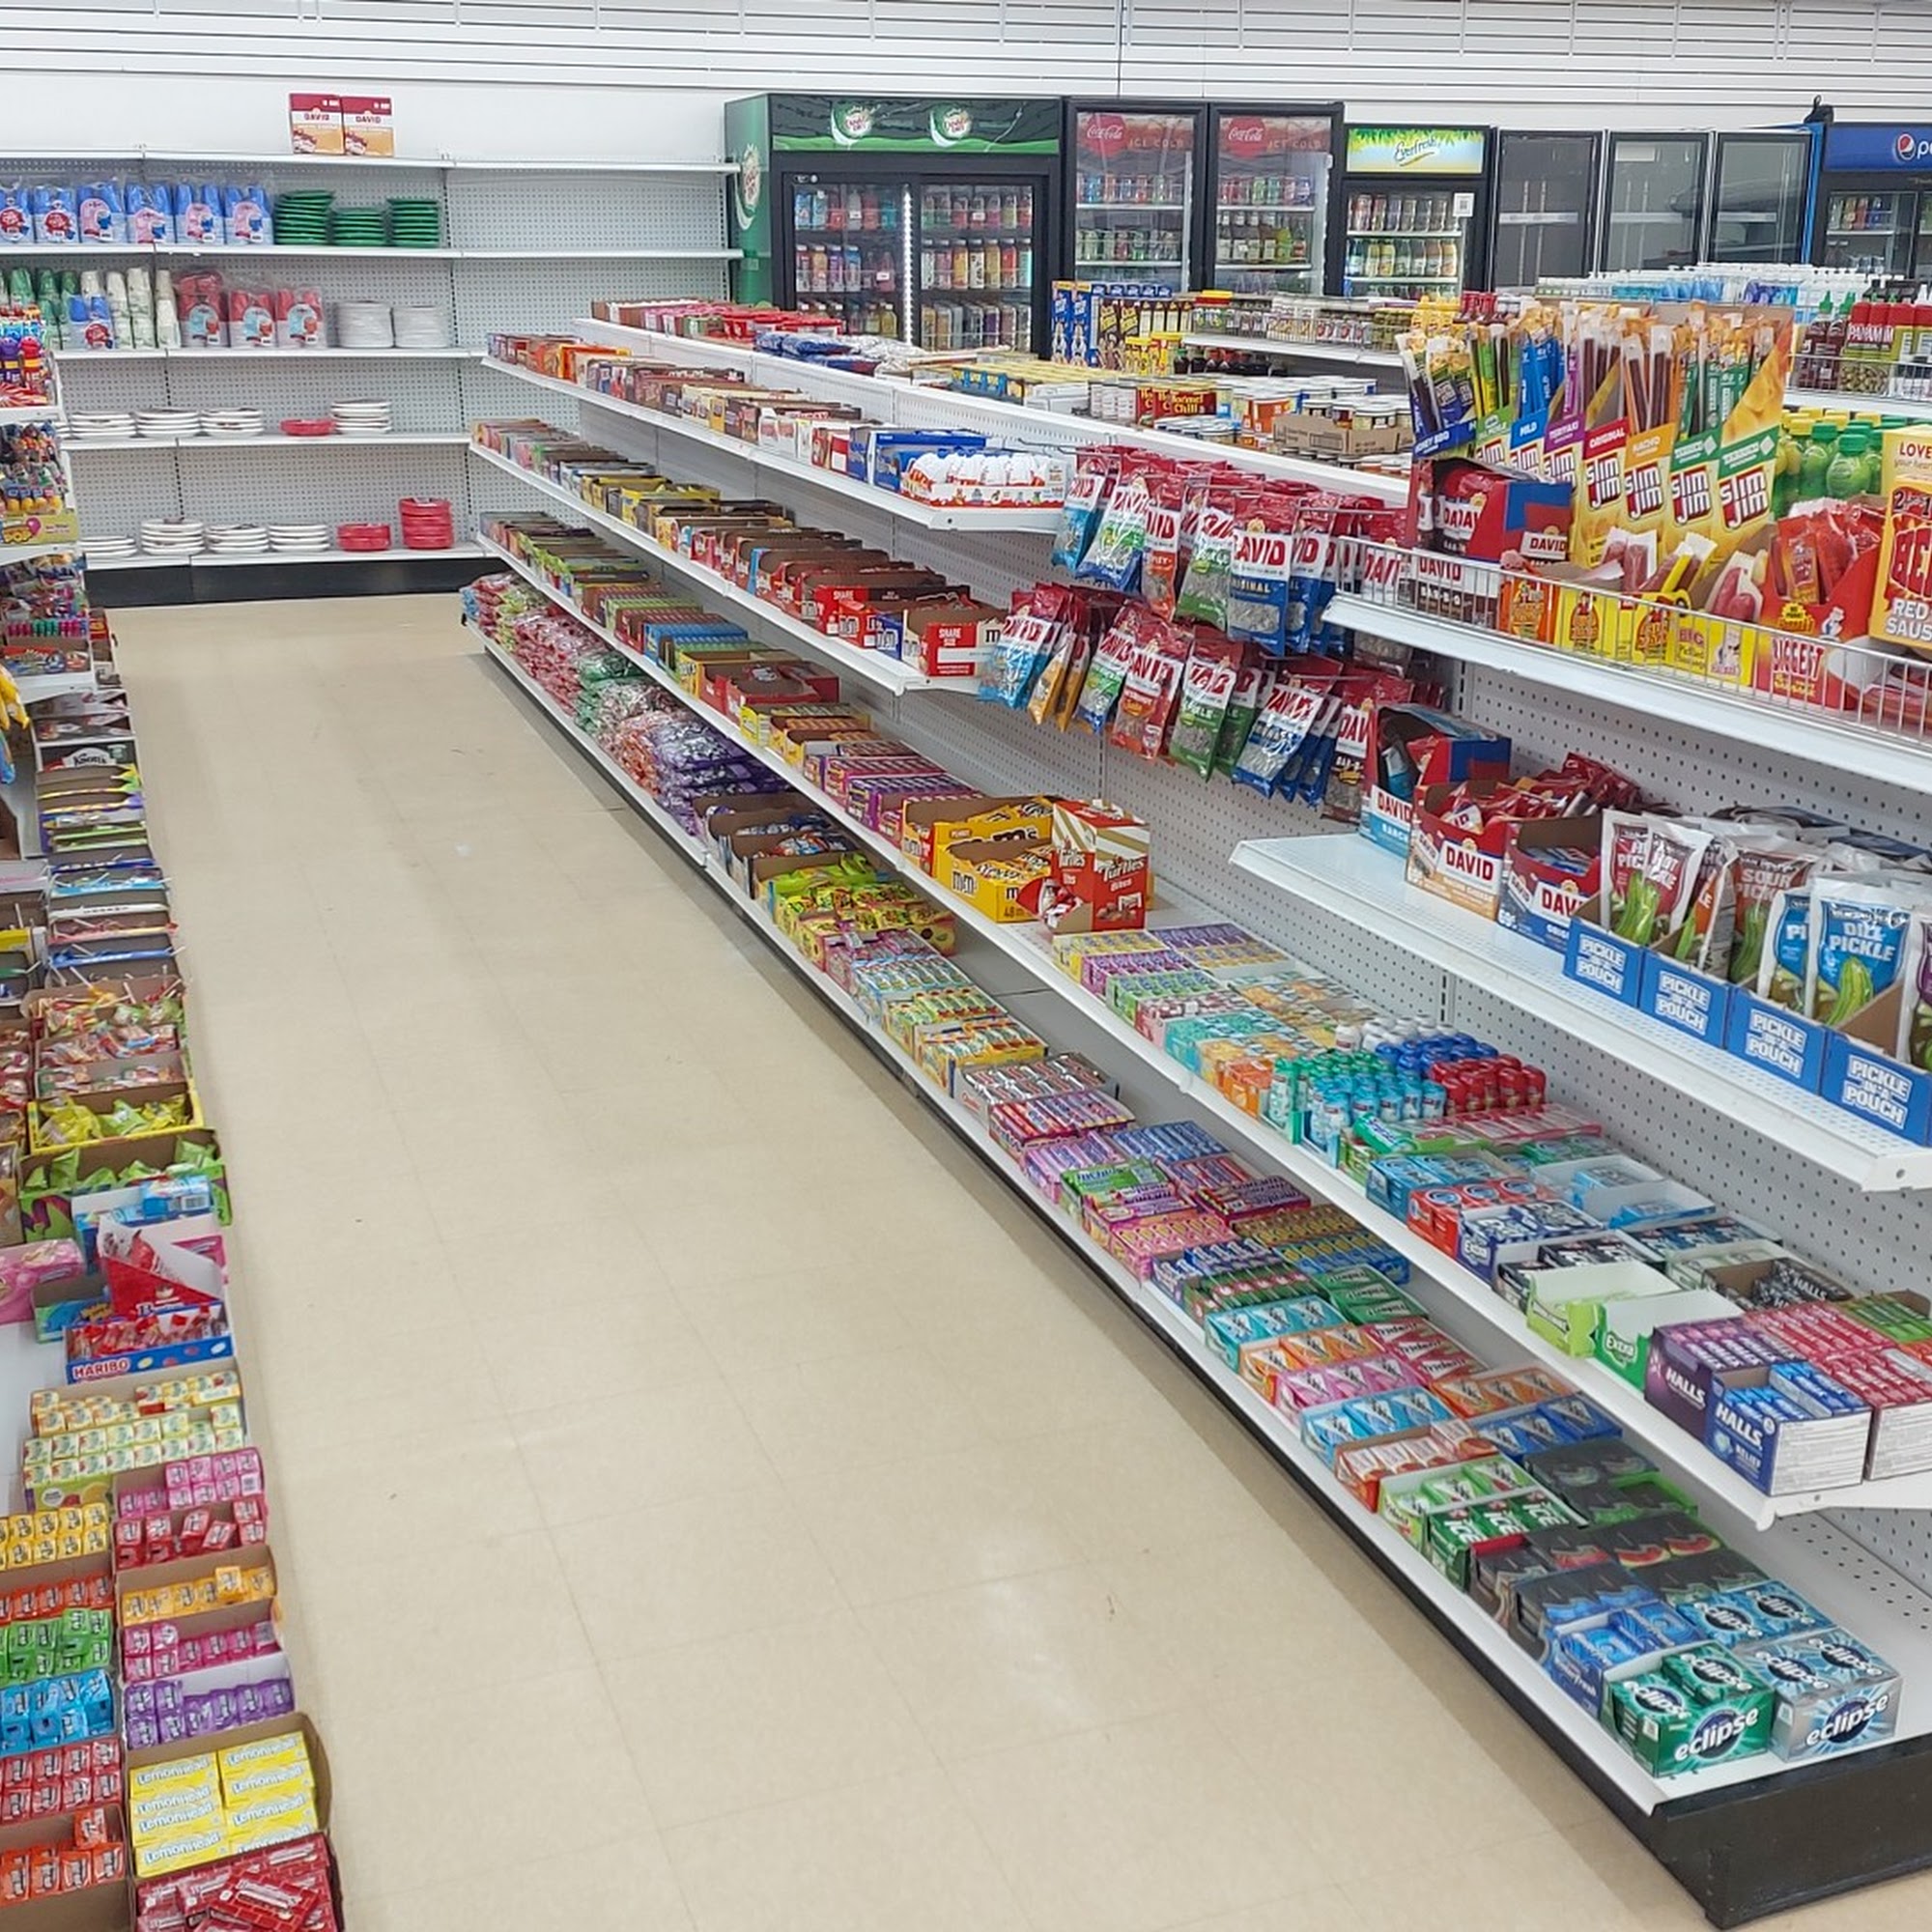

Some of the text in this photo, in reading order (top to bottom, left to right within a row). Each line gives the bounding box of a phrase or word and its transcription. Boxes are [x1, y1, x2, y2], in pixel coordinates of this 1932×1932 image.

[1175, 404, 1198, 414] Chili
[1520, 422, 1537, 437] MILD
[1510, 446, 1539, 469] slim
[1544, 451, 1574, 476] slim
[1586, 456, 1620, 481] slim
[1591, 477, 1620, 508] jim
[1625, 465, 1661, 494] slim
[1671, 469, 1708, 497] slim
[1720, 471, 1766, 505] slim
[1631, 487, 1662, 519] jim
[1677, 491, 1711, 524] jim
[1728, 493, 1769, 528] jim
[1234, 535, 1287, 566] AVID
[1530, 537, 1567, 552] DAVID
[1893, 598, 1929, 620] RED
[939, 628, 961, 639] SHARE
[1103, 860, 1145, 883] Turtles
[1446, 846, 1493, 881] DAVID
[1741, 869, 1792, 888] SOUR
[1542, 889, 1584, 918] DAV
[1580, 936, 1625, 968] PICKLE
[1830, 935, 1895, 962] PICKLE
[1577, 960, 1623, 994] POUCH
[1662, 974, 1710, 1009] PICKLE
[1658, 997, 1707, 1033] POUCH
[1752, 1012, 1804, 1050] PICKLE
[1748, 1037, 1802, 1075] POUCH
[1851, 1059, 1910, 1097] PICKLE
[1846, 1086, 1905, 1124] POUCH
[1793, 1276, 1828, 1300] HALLS
[73, 1358, 129, 1379] HARIBO
[1665, 1366, 1707, 1403] HALLS
[1716, 1403, 1764, 1449] HALLS
[1693, 1602, 1764, 1638] eclipse
[1747, 1590, 1816, 1626] eclipse
[1679, 1652, 1752, 1691] eclipse
[1754, 1650, 1830, 1690] eclipse
[1808, 1638, 1883, 1676] eclipse
[1622, 1681, 1690, 1719] eclipse
[1673, 1707, 1759, 1762] eclipse
[1806, 1694, 1889, 1747] eclipse
